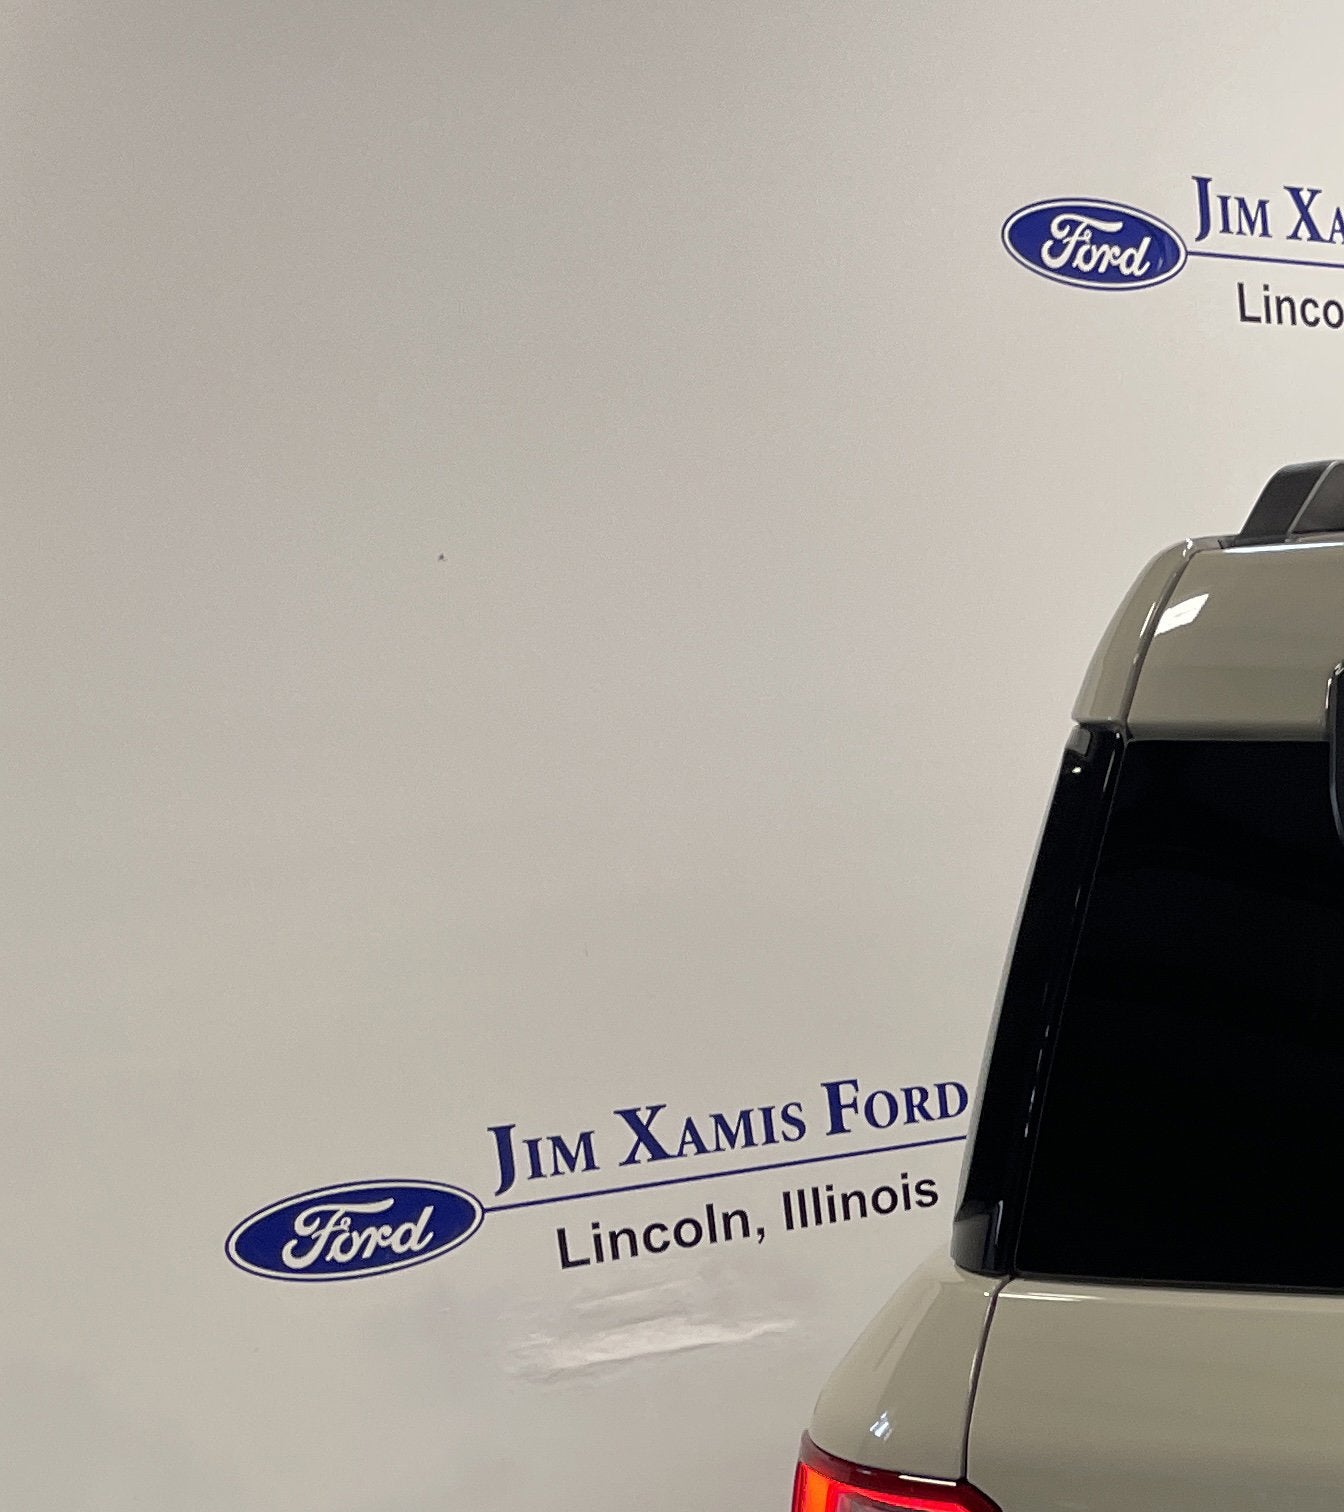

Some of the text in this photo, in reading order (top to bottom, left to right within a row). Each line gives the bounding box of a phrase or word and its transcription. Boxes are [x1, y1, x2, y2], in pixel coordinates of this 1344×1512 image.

[1192, 175, 1270, 241] JIM
[1040, 213, 1150, 277] Ford
[488, 1079, 968, 1195] JIM XAMIS FORD
[283, 1200, 433, 1269] Ford
[557, 1173, 939, 1269] Lincoln, Illinois
